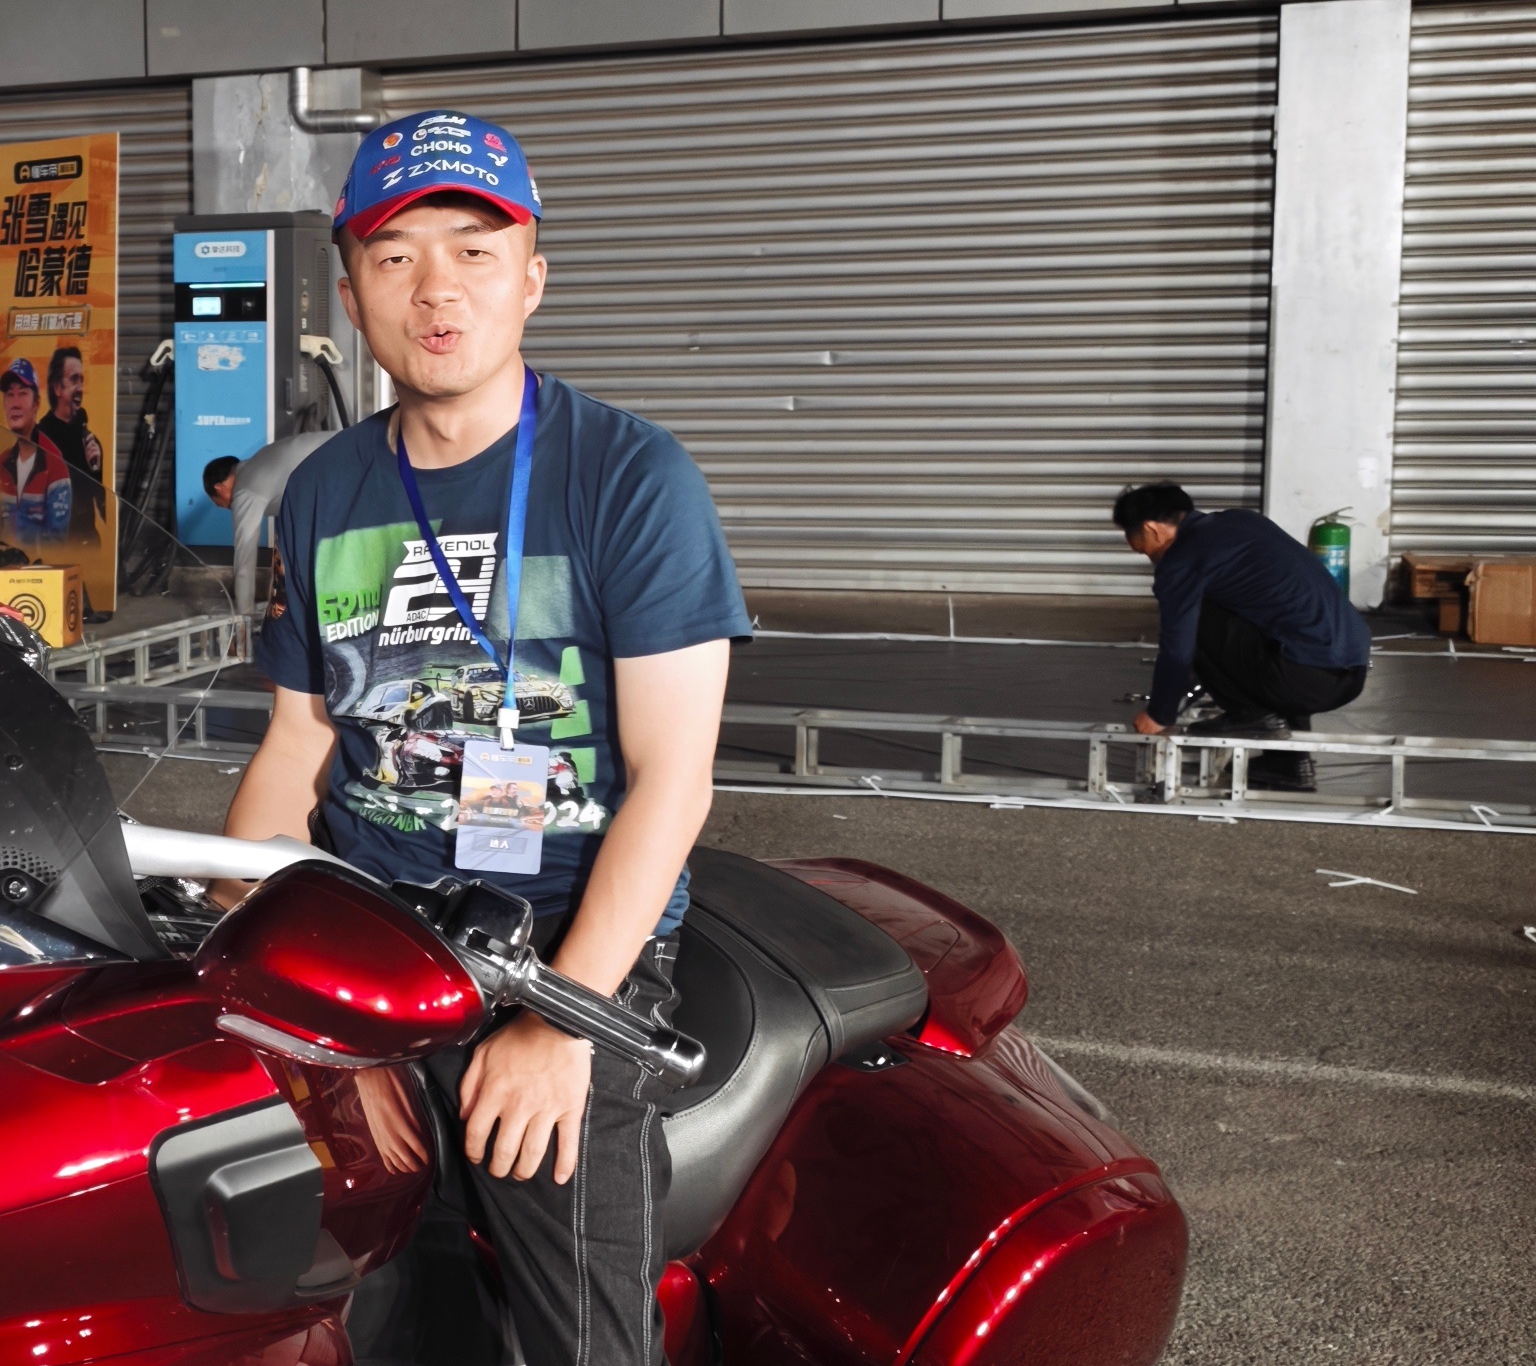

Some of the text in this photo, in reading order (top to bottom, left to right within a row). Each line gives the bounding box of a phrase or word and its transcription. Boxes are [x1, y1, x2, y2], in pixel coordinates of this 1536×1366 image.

[411, 140, 472, 156] CHOHO
[408, 160, 499, 185] ZXMOTO
[14, 243, 93, 297] 哈蒙德
[413, 539, 491, 557] RAENOL
[327, 609, 380, 642] EDITION
[406, 610, 428, 623] ADAC
